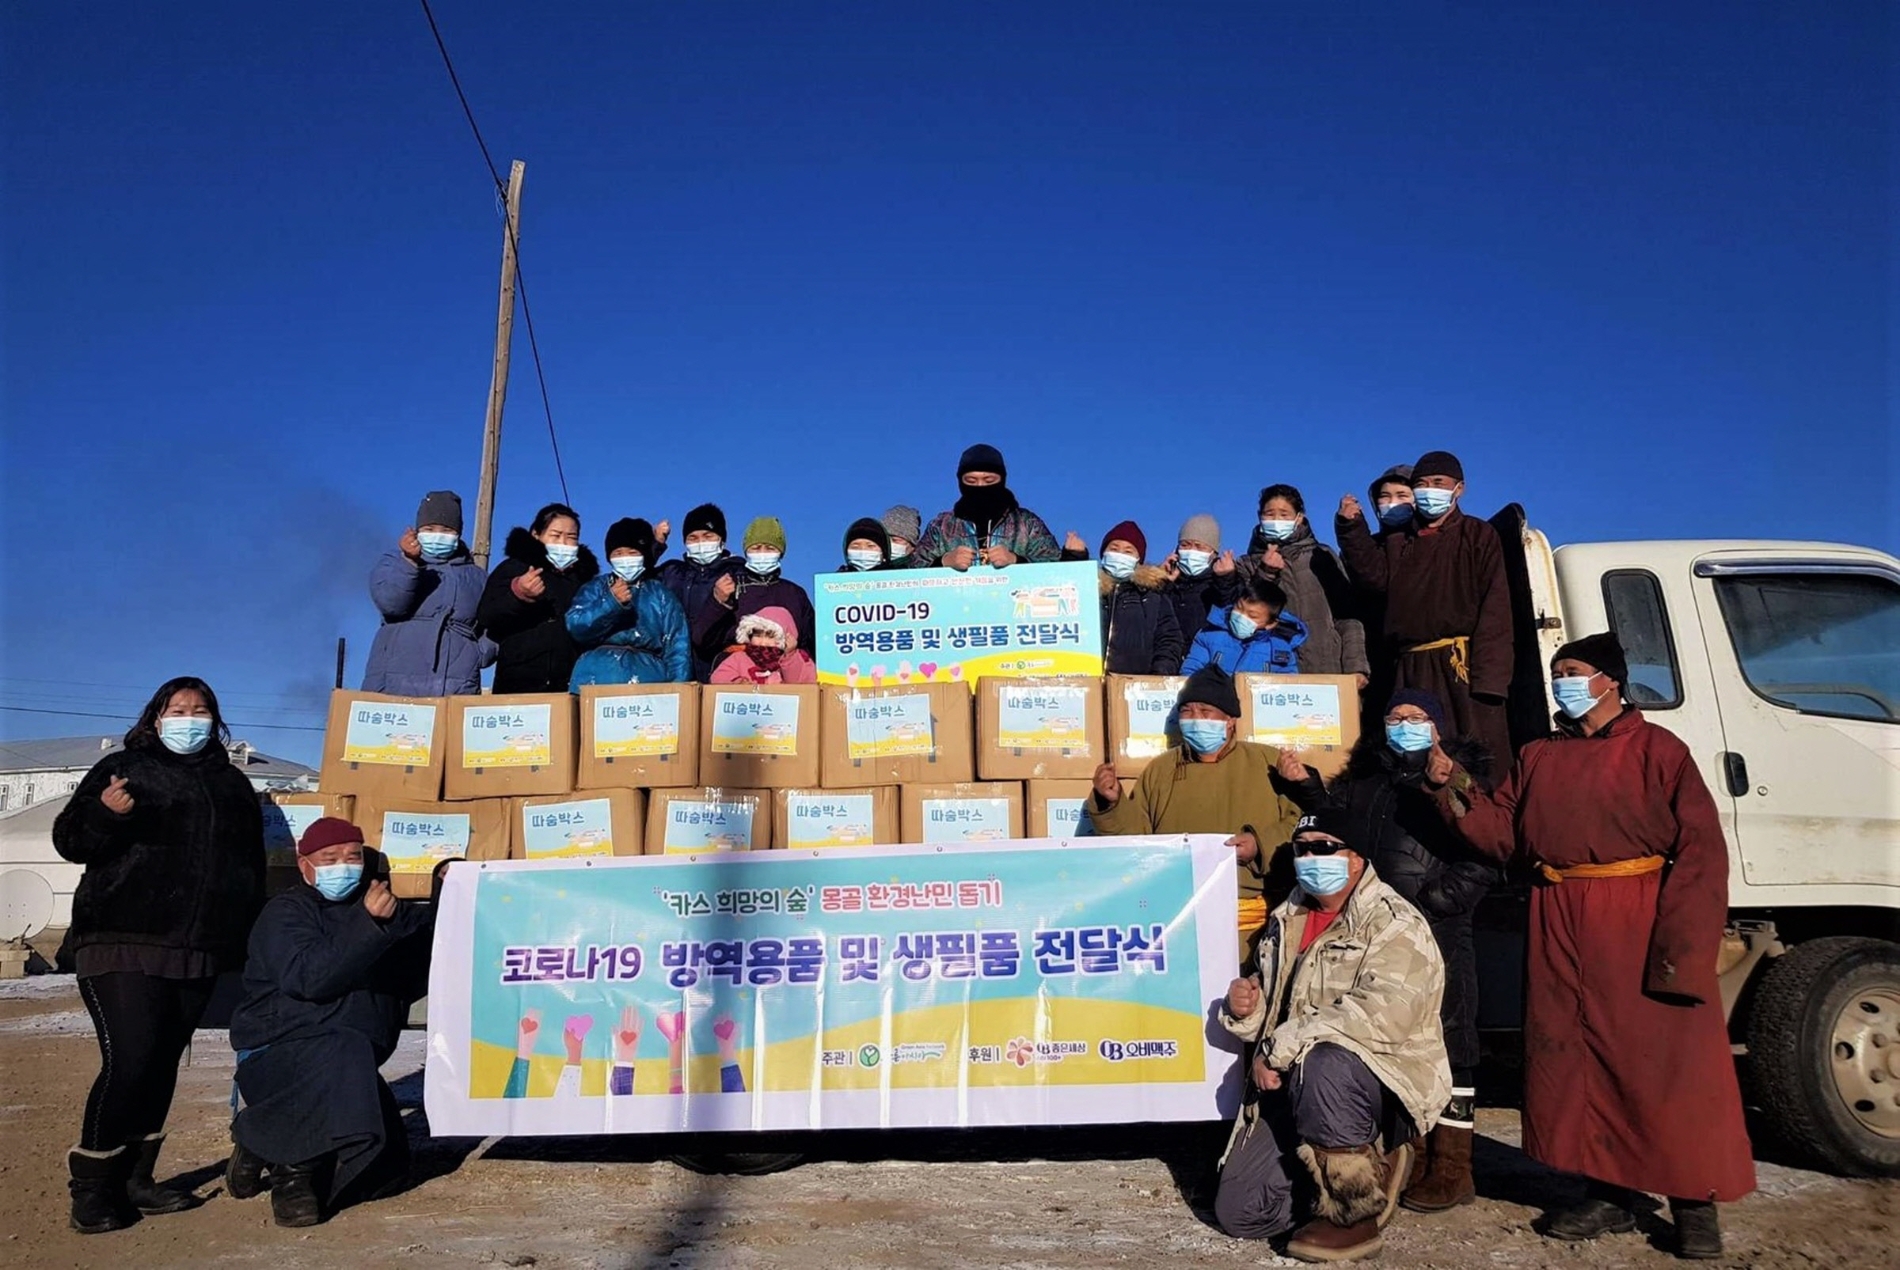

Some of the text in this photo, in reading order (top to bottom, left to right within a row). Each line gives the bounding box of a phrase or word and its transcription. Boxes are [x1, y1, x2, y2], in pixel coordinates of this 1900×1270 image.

[835, 603, 930, 623] COVID-19
[835, 623, 1080, 654] 방역용품 및 생필품 전달식
[1136, 699, 1175, 711] 따숨박
[663, 881, 1001, 915] '카스 희망의 숲' 몽골 환경난민 돕기
[502, 926, 1165, 987] 코로나19 방역용품 및 생필품 전달식
[822, 1051, 845, 1065] 주관
[969, 1048, 992, 1061] 후원
[1100, 1040, 1176, 1060] OB 오비맥주
